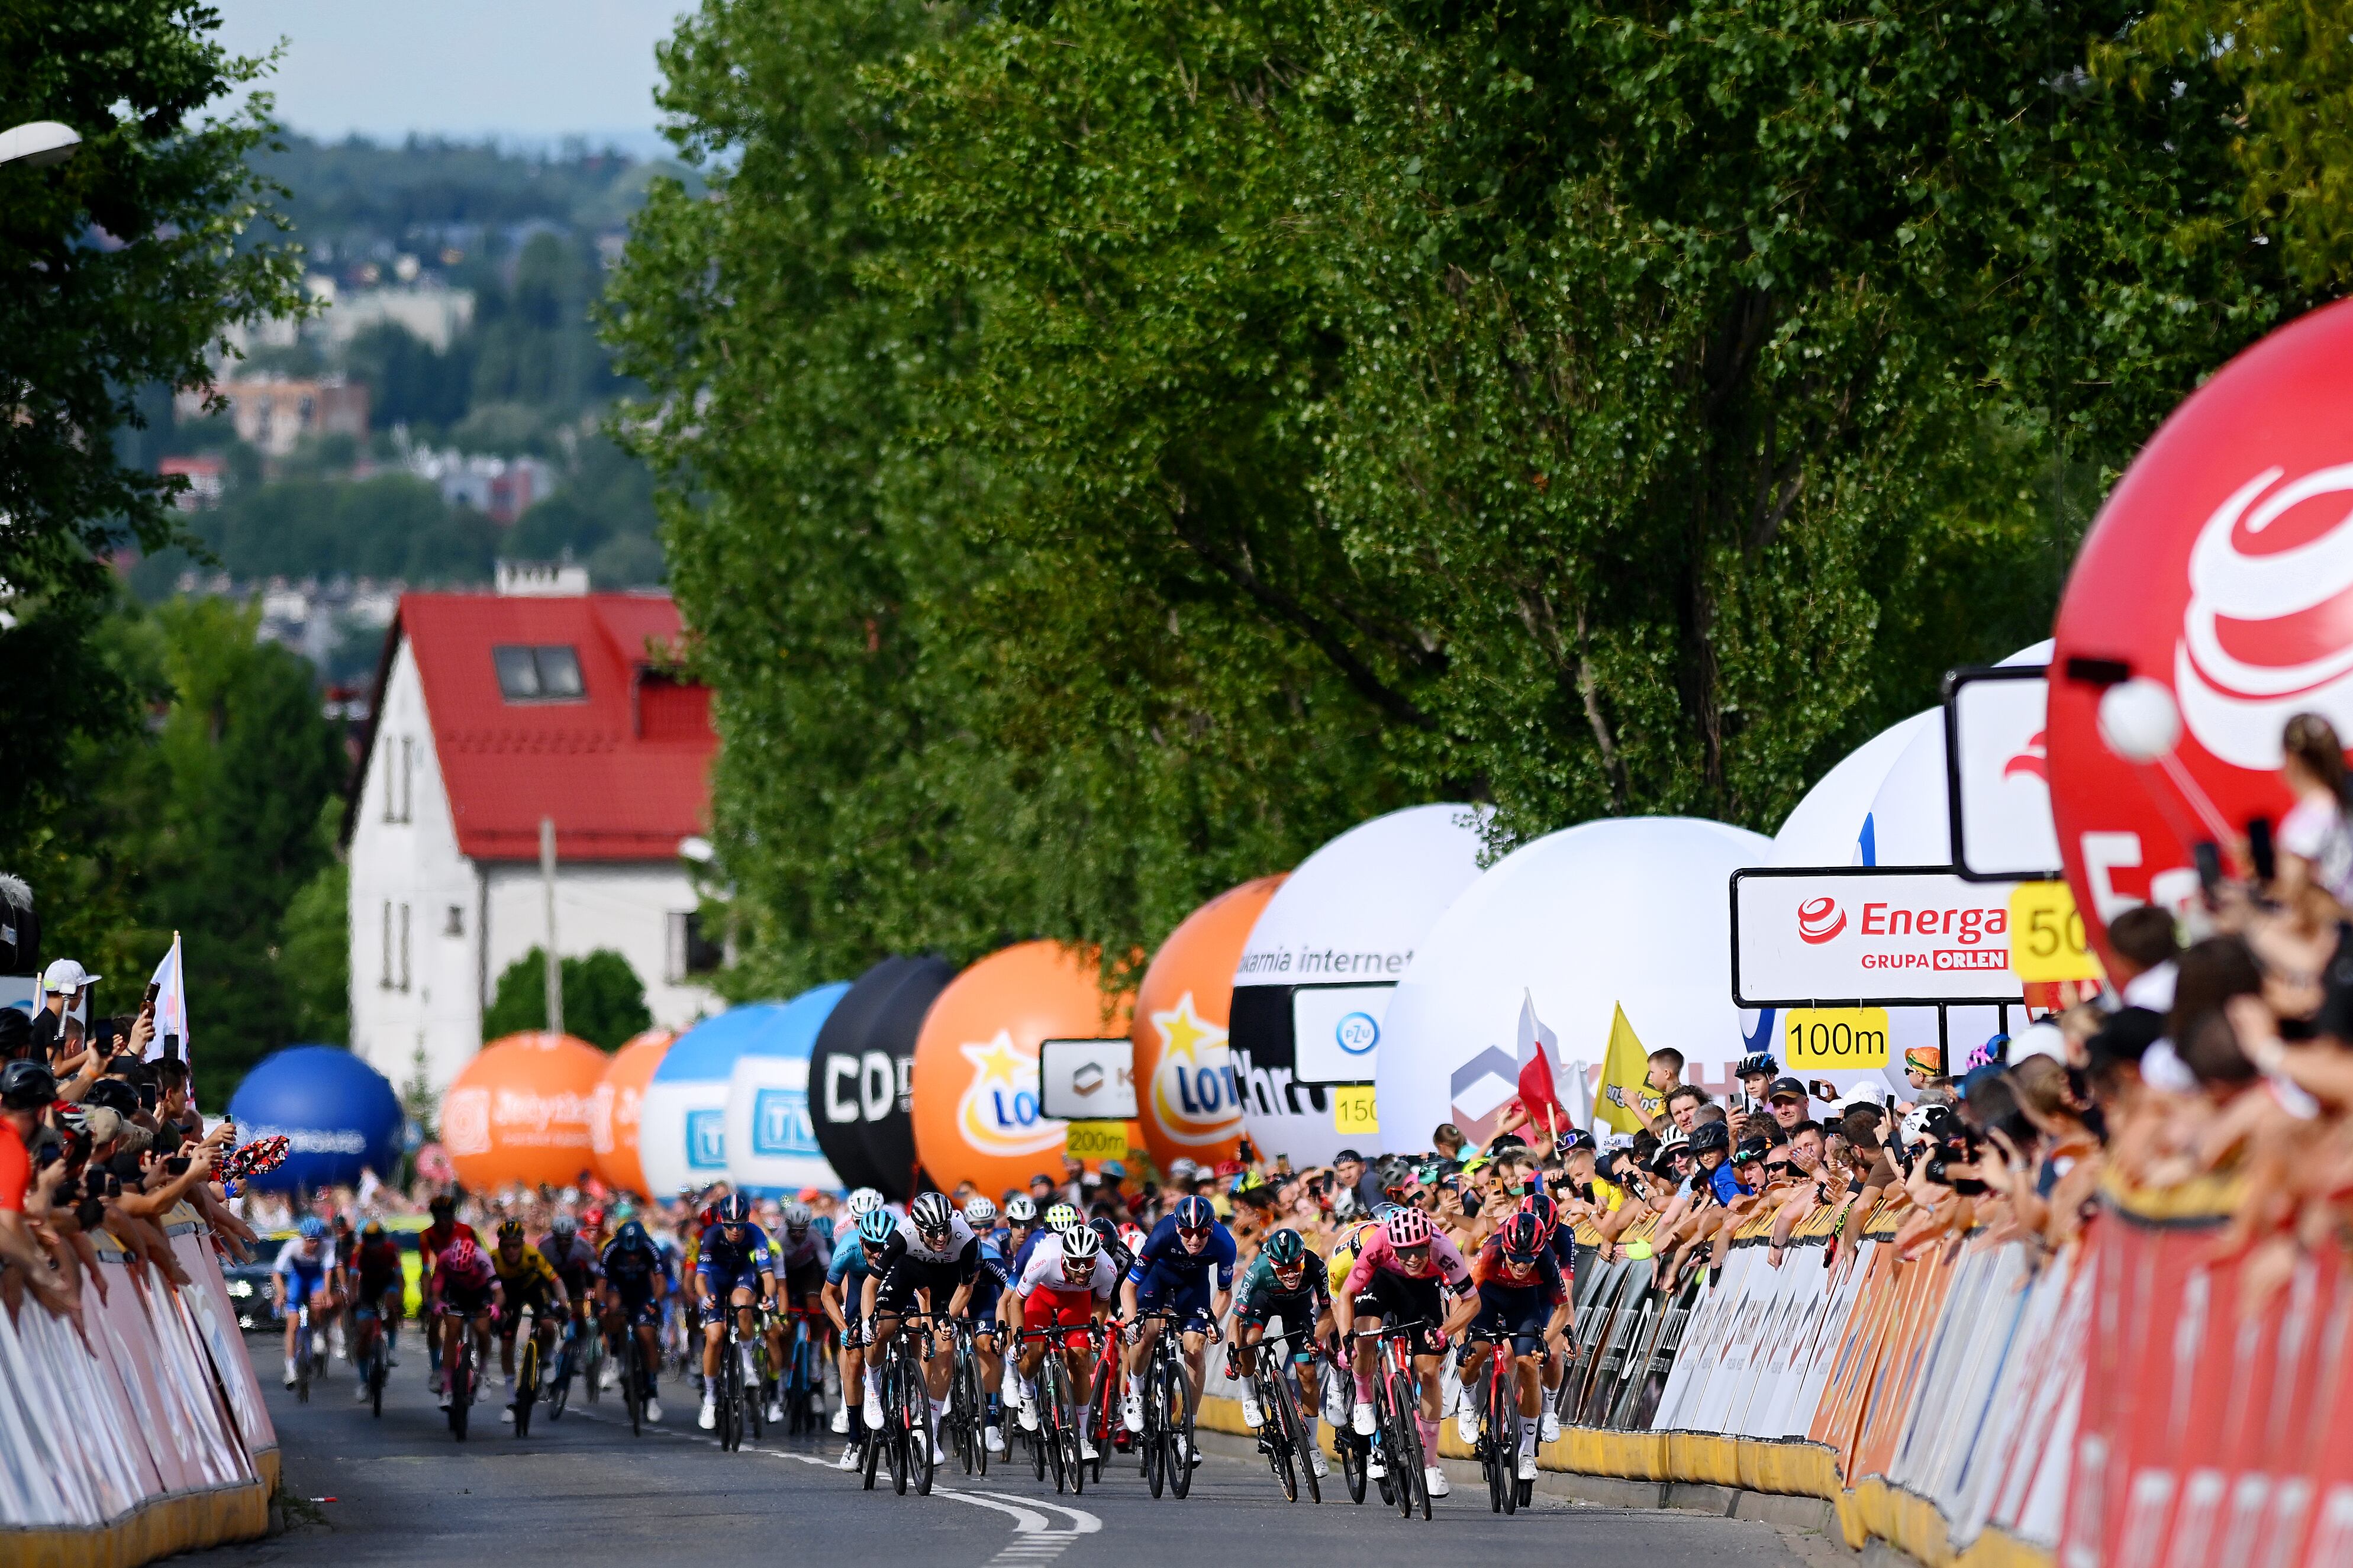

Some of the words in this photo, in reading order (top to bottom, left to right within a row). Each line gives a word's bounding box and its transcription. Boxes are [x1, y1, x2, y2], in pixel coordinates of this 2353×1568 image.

[1861, 903, 2007, 944] Energa
[1861, 954, 1929, 969] GRUPA
[1936, 951, 2004, 969] ORLEN
[1345, 1024, 1371, 1043] PZU
[1790, 1022, 1884, 1056] 100m
[1069, 1130, 1126, 1151] 200m
[1028, 1259, 1047, 1274] POLSKA
